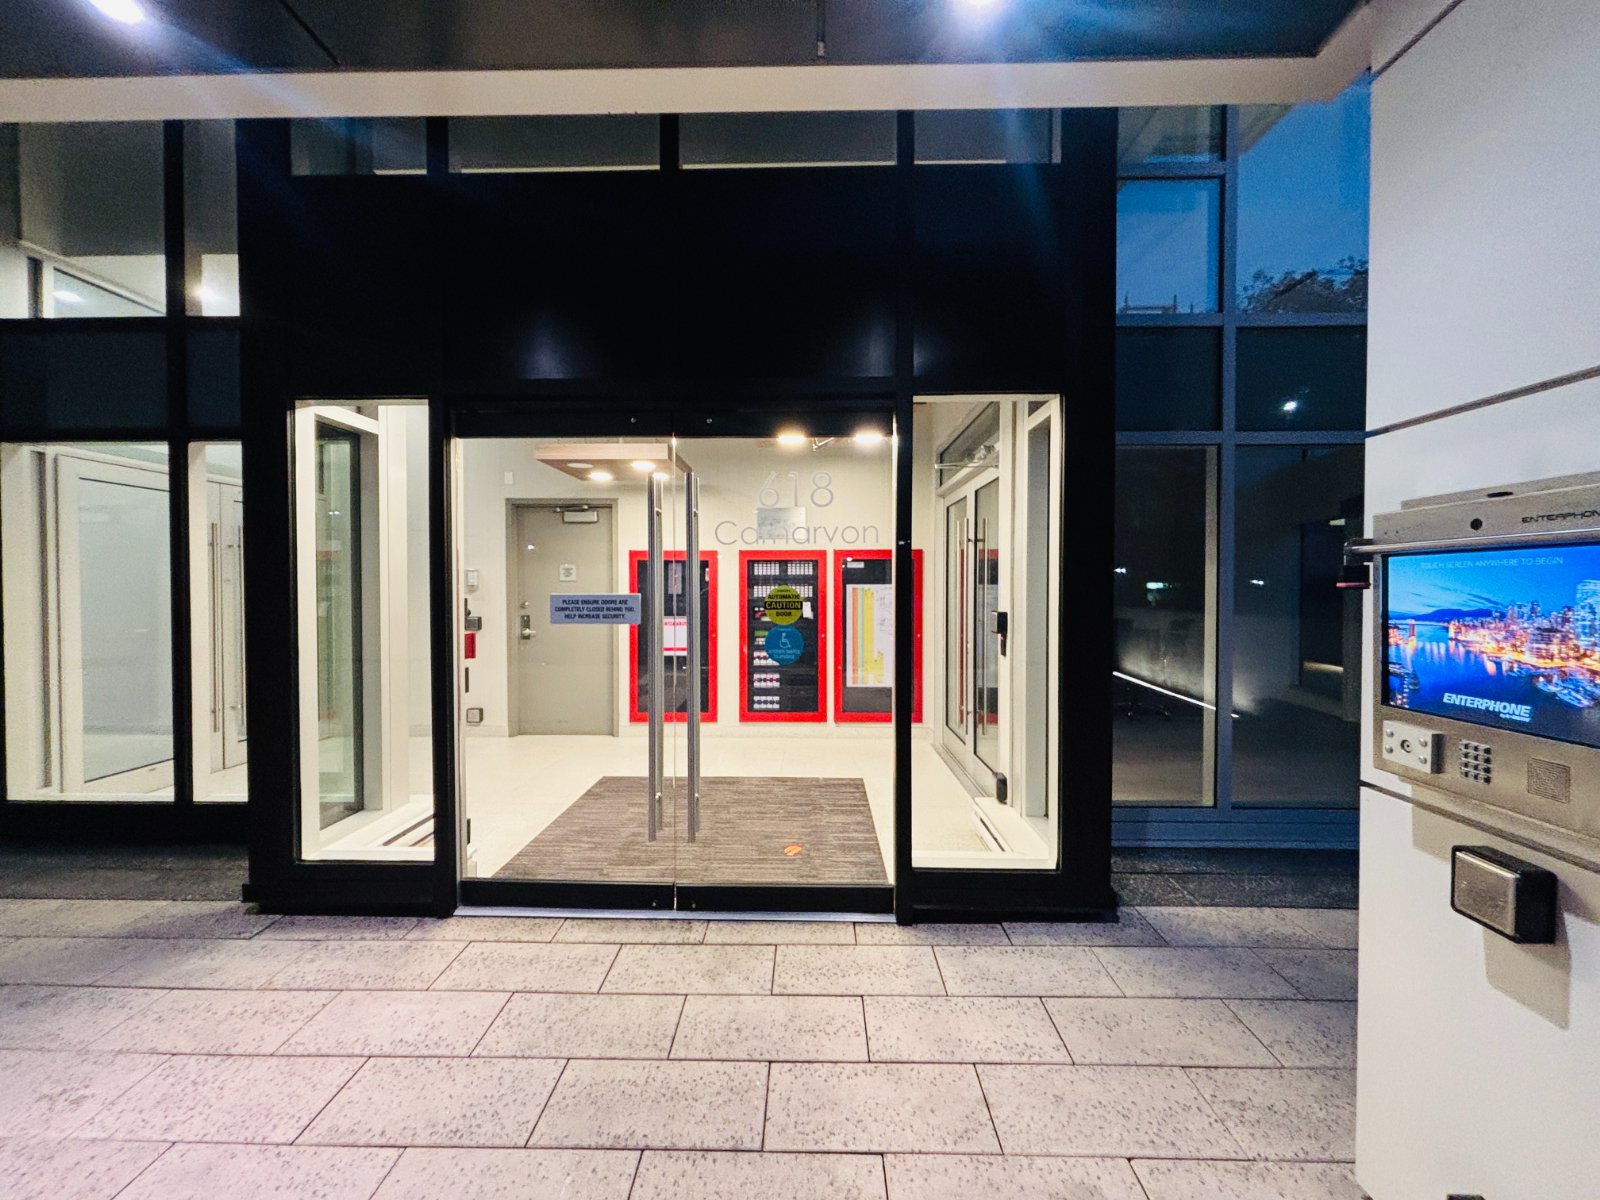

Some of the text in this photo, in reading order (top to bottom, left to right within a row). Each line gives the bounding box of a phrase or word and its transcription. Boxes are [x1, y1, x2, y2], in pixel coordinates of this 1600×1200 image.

[759, 471, 834, 507] 618
[1446, 560, 1473, 568] SCREEN
[1475, 558, 1519, 567] ANYWHERE
[1521, 558, 1533, 566] TO
[1535, 557, 1564, 565] BEGIN
[765, 601, 801, 609] CAUTION
[1442, 692, 1532, 717] ENTERPHONE
